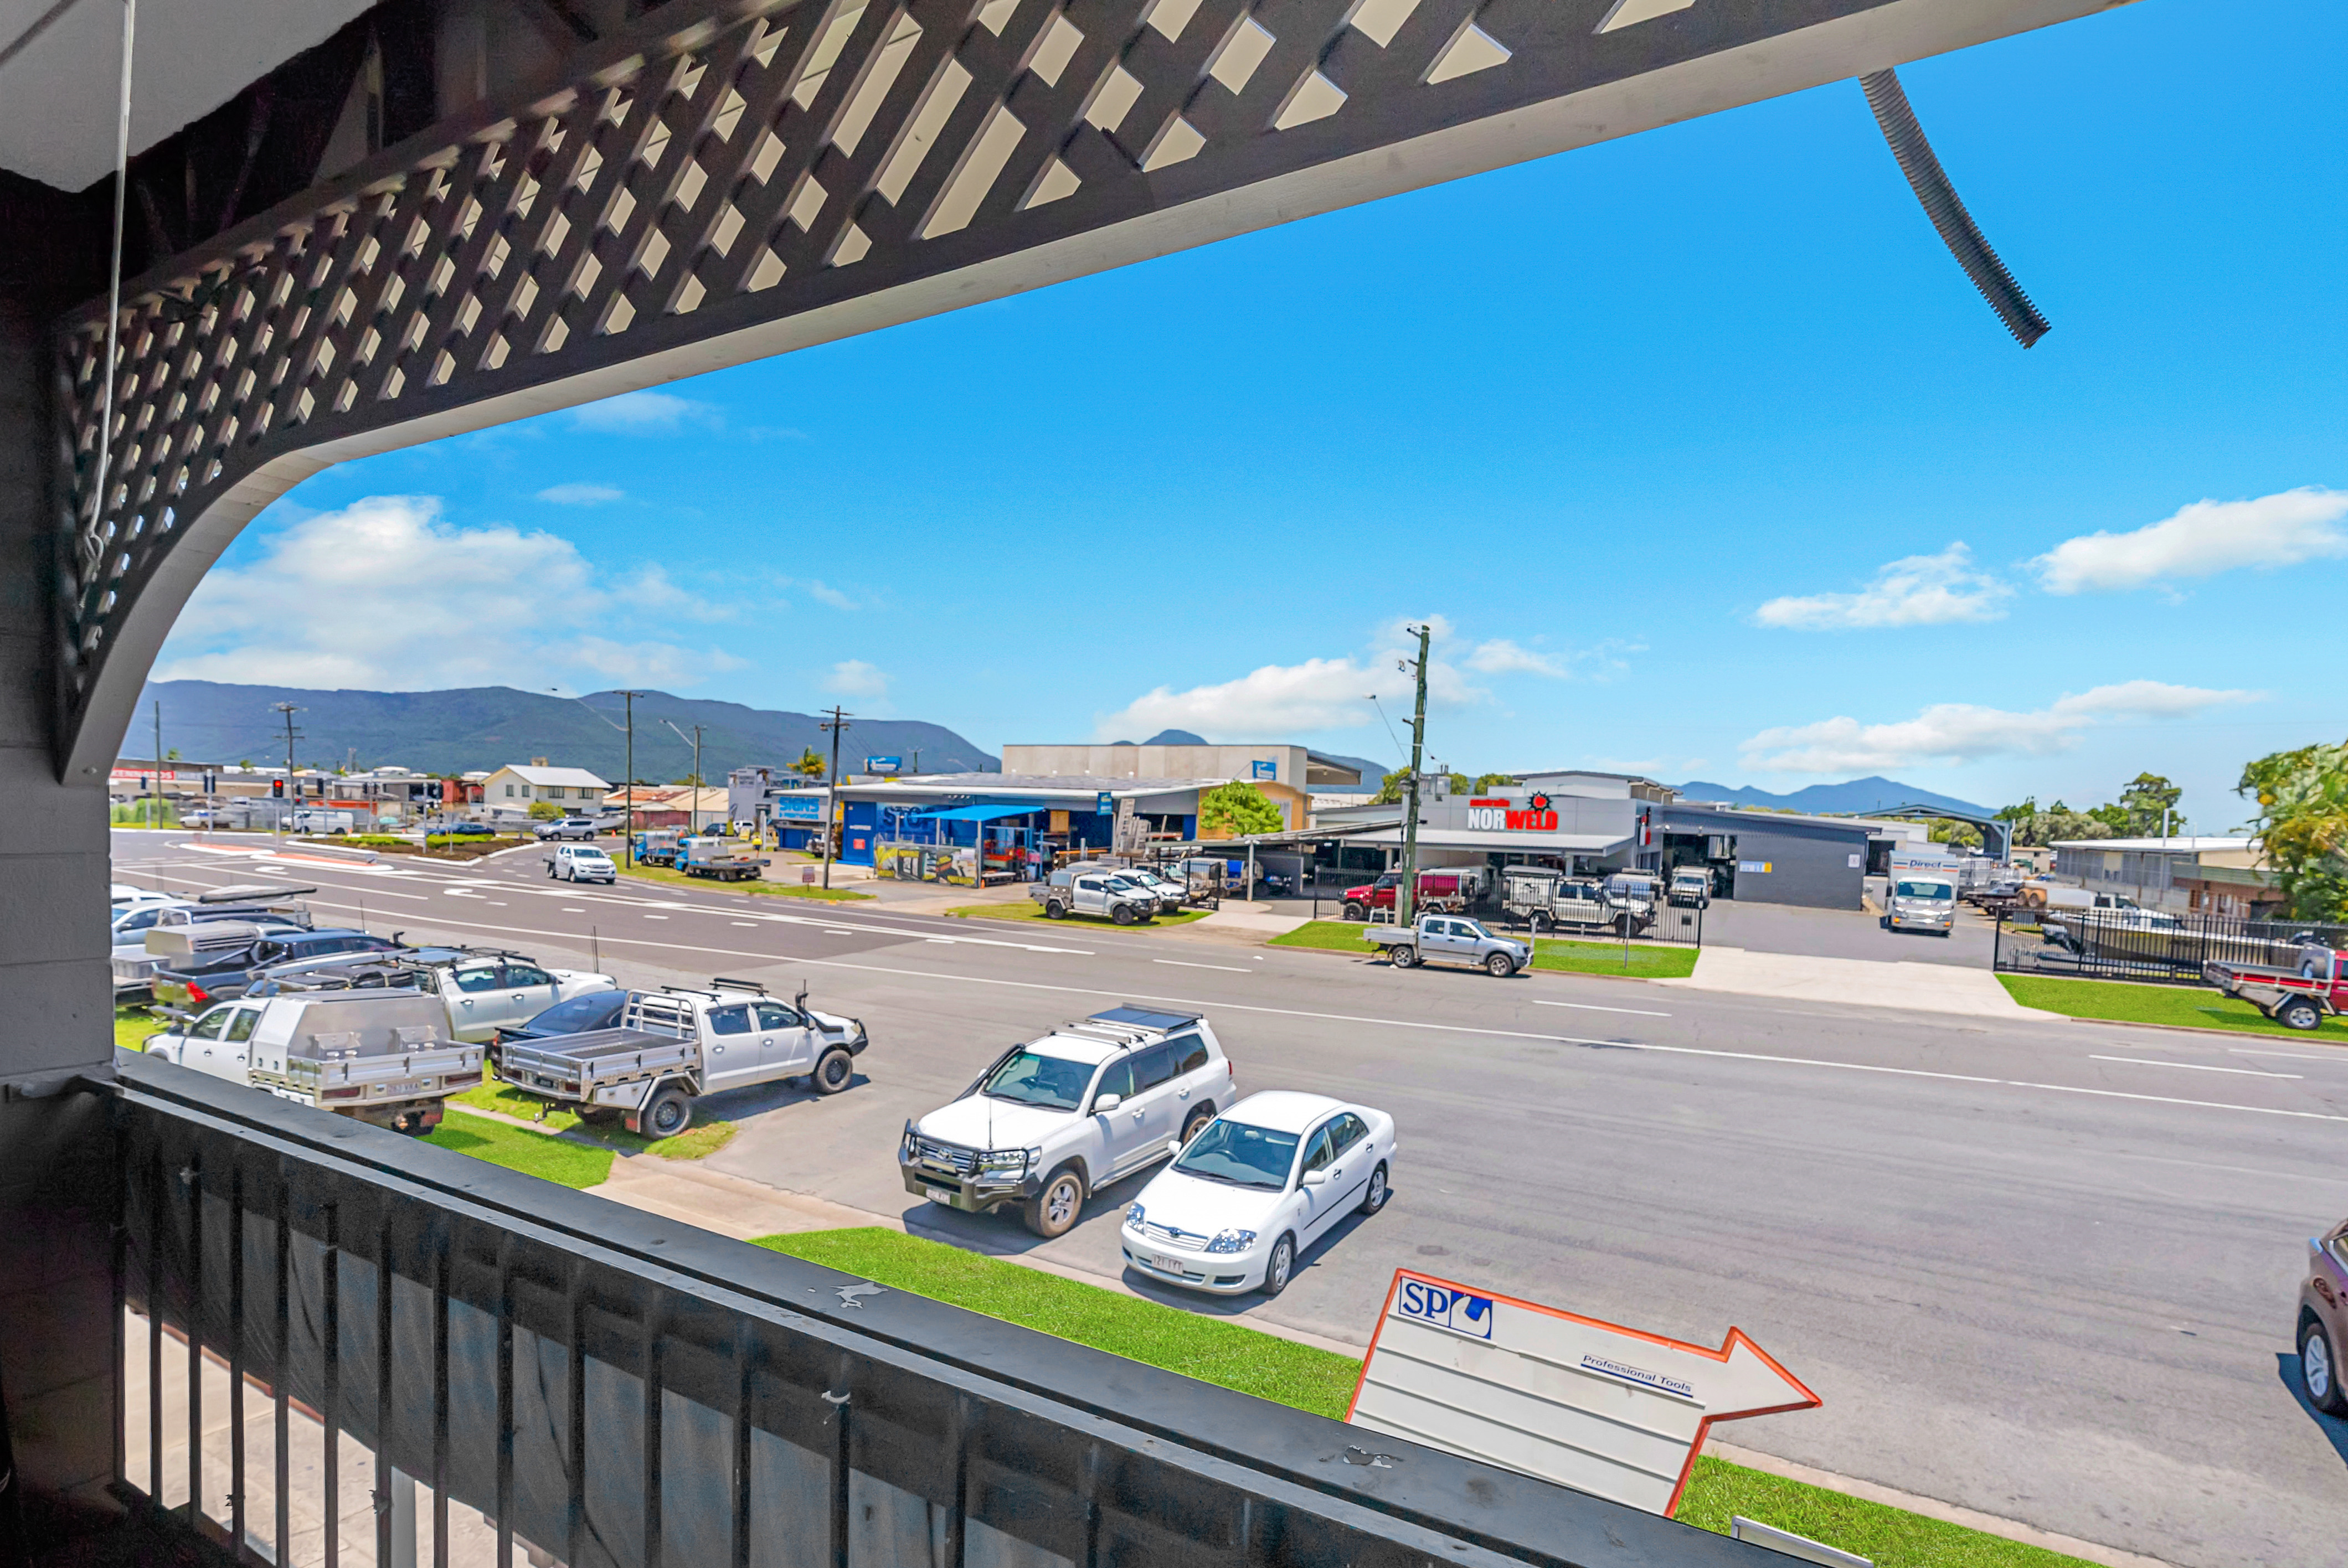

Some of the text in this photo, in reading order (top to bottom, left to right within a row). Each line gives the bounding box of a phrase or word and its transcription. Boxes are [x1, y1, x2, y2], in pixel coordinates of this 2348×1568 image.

[779, 797, 819, 812] SIGNS
[1468, 808, 1558, 831] NORWELD
[1909, 860, 1941, 868] Direct
[1403, 1283, 1448, 1319] SP
[1583, 1355, 1691, 1392] Professional Tools
